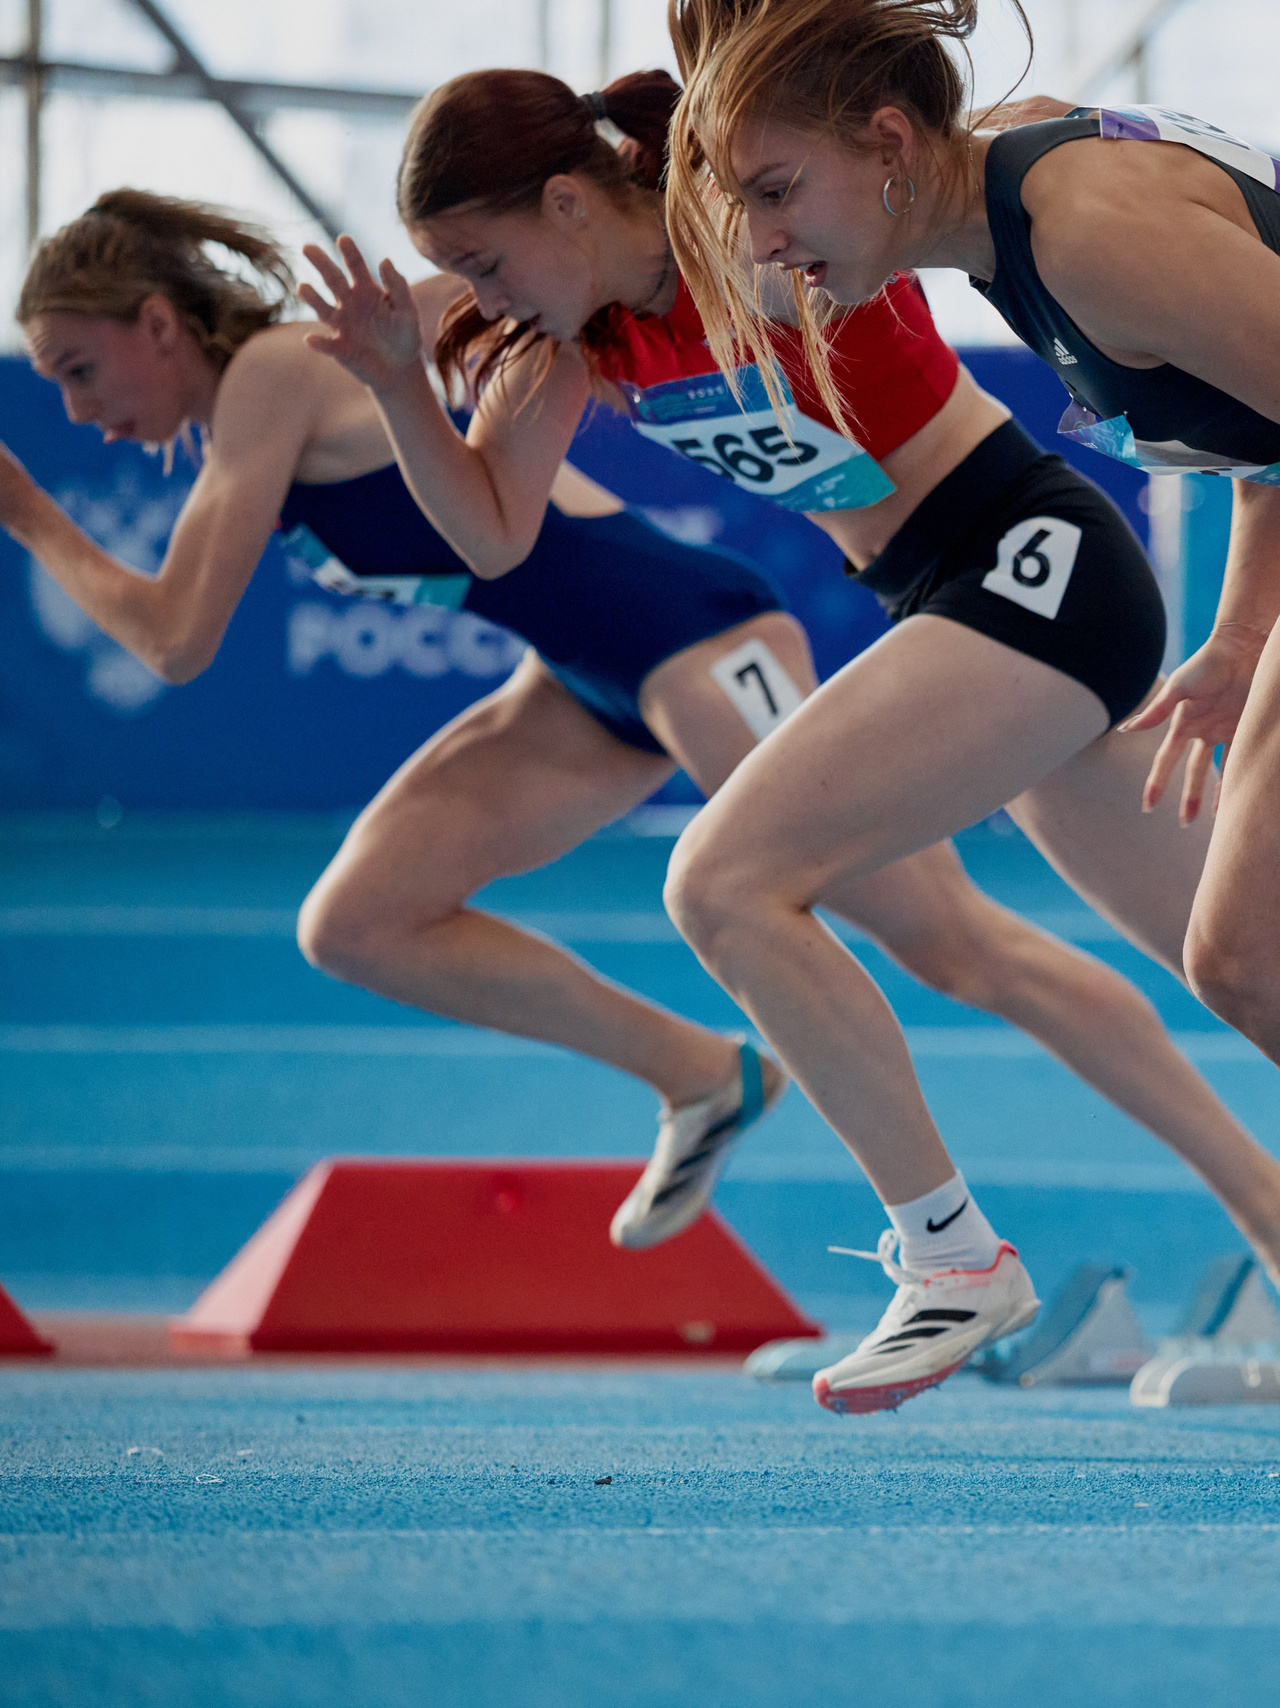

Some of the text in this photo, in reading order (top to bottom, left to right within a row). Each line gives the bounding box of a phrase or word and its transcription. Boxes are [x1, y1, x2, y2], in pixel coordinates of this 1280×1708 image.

[671, 426, 819, 484] 565
[1013, 528, 1052, 588] 6
[735, 663, 778, 718] 7
